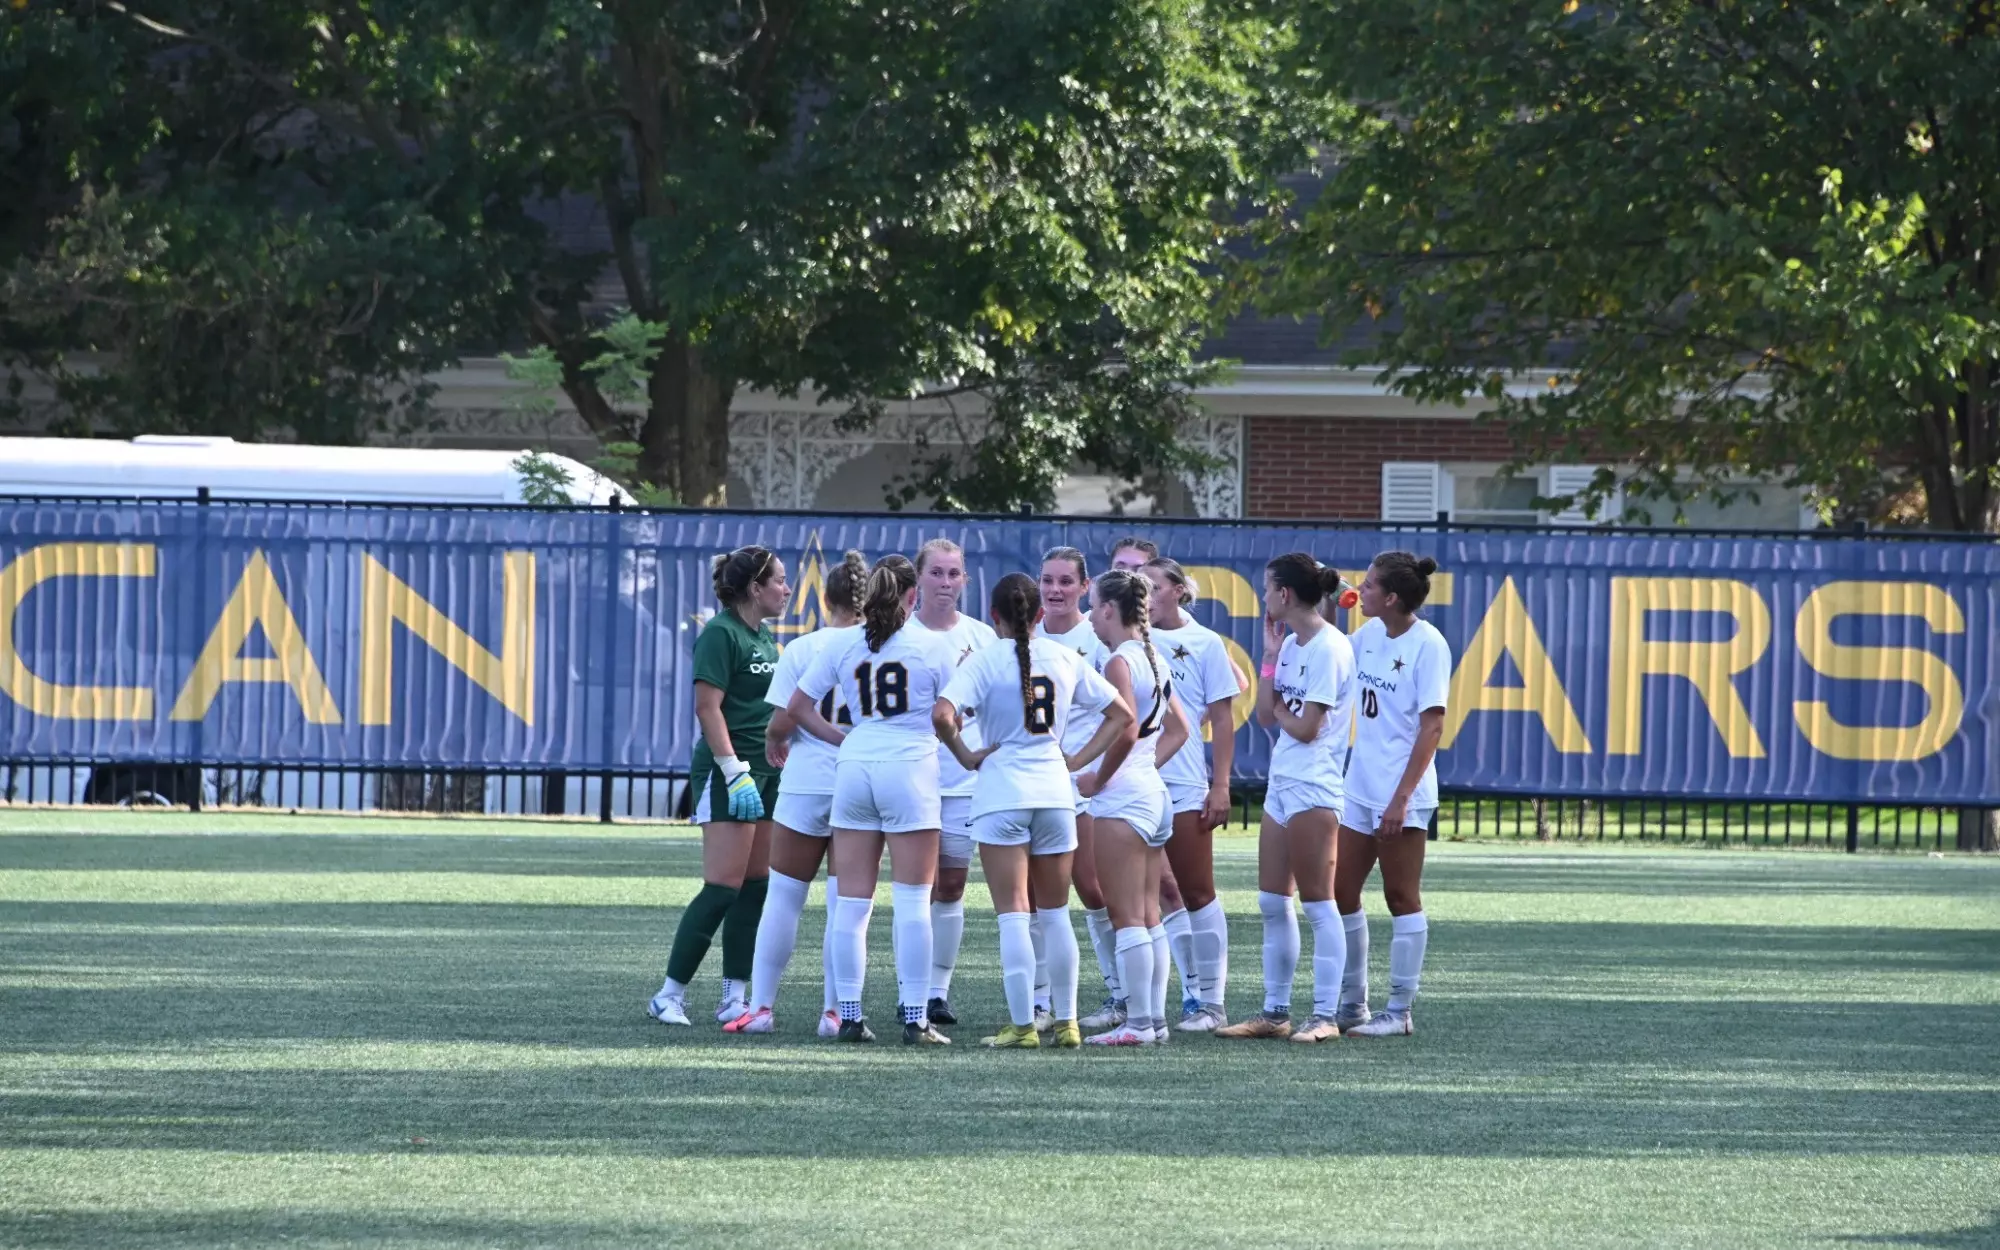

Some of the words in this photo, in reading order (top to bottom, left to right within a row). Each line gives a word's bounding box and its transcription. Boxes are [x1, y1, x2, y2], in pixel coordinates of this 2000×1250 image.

[0, 542, 536, 727] CAN
[853, 660, 909, 718] 18
[1361, 687, 1379, 719] 10
